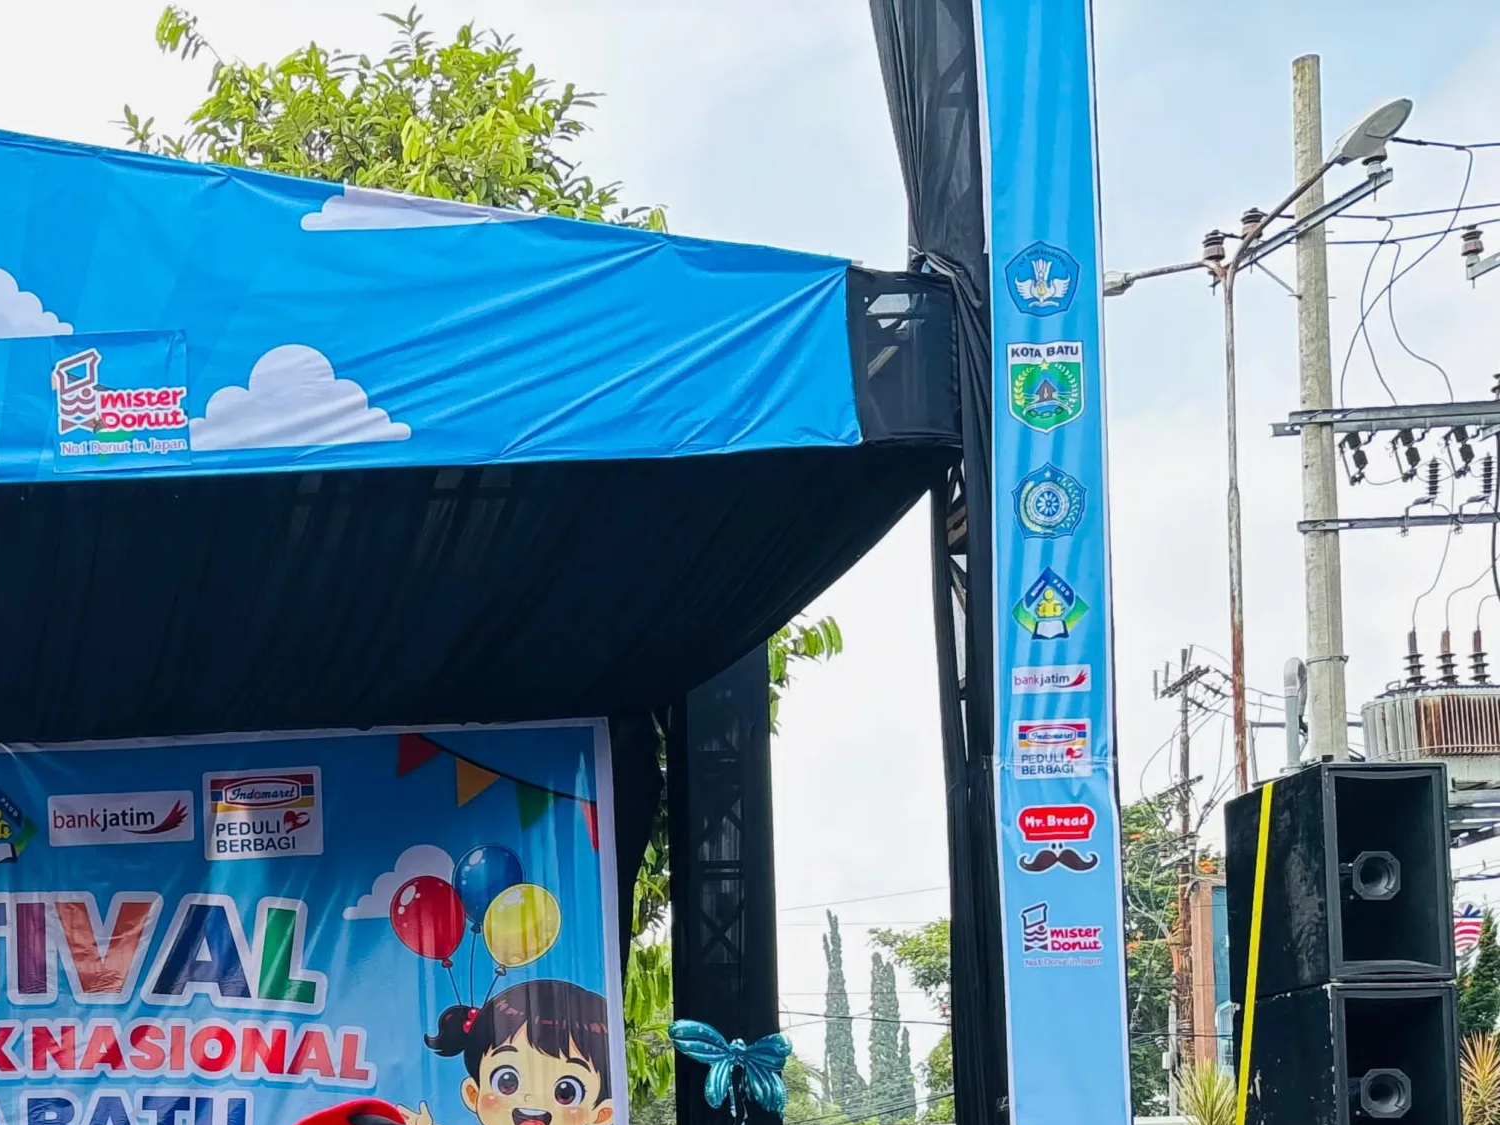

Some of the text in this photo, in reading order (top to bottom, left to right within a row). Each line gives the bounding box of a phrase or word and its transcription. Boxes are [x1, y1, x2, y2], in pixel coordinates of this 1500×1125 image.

[1011, 345, 1079, 358] KOTA BATU
[100, 410, 186, 430] Donut
[91, 441, 130, 453] Donut
[135, 439, 147, 450] in
[150, 438, 186, 453] Japan
[1021, 753, 1064, 763] PEDULI
[1021, 764, 1074, 775] BERBAGI
[228, 785, 296, 801] Indomaret
[0, 797, 18, 817] PAUD
[53, 808, 155, 832] bankjatim
[1025, 813, 1089, 828] Mr. Bread
[216, 820, 281, 837] PEDULI
[216, 836, 296, 853] BERBAGI
[1050, 940, 1102, 951] Donut
[32, 1024, 371, 1082] NASIONAL
